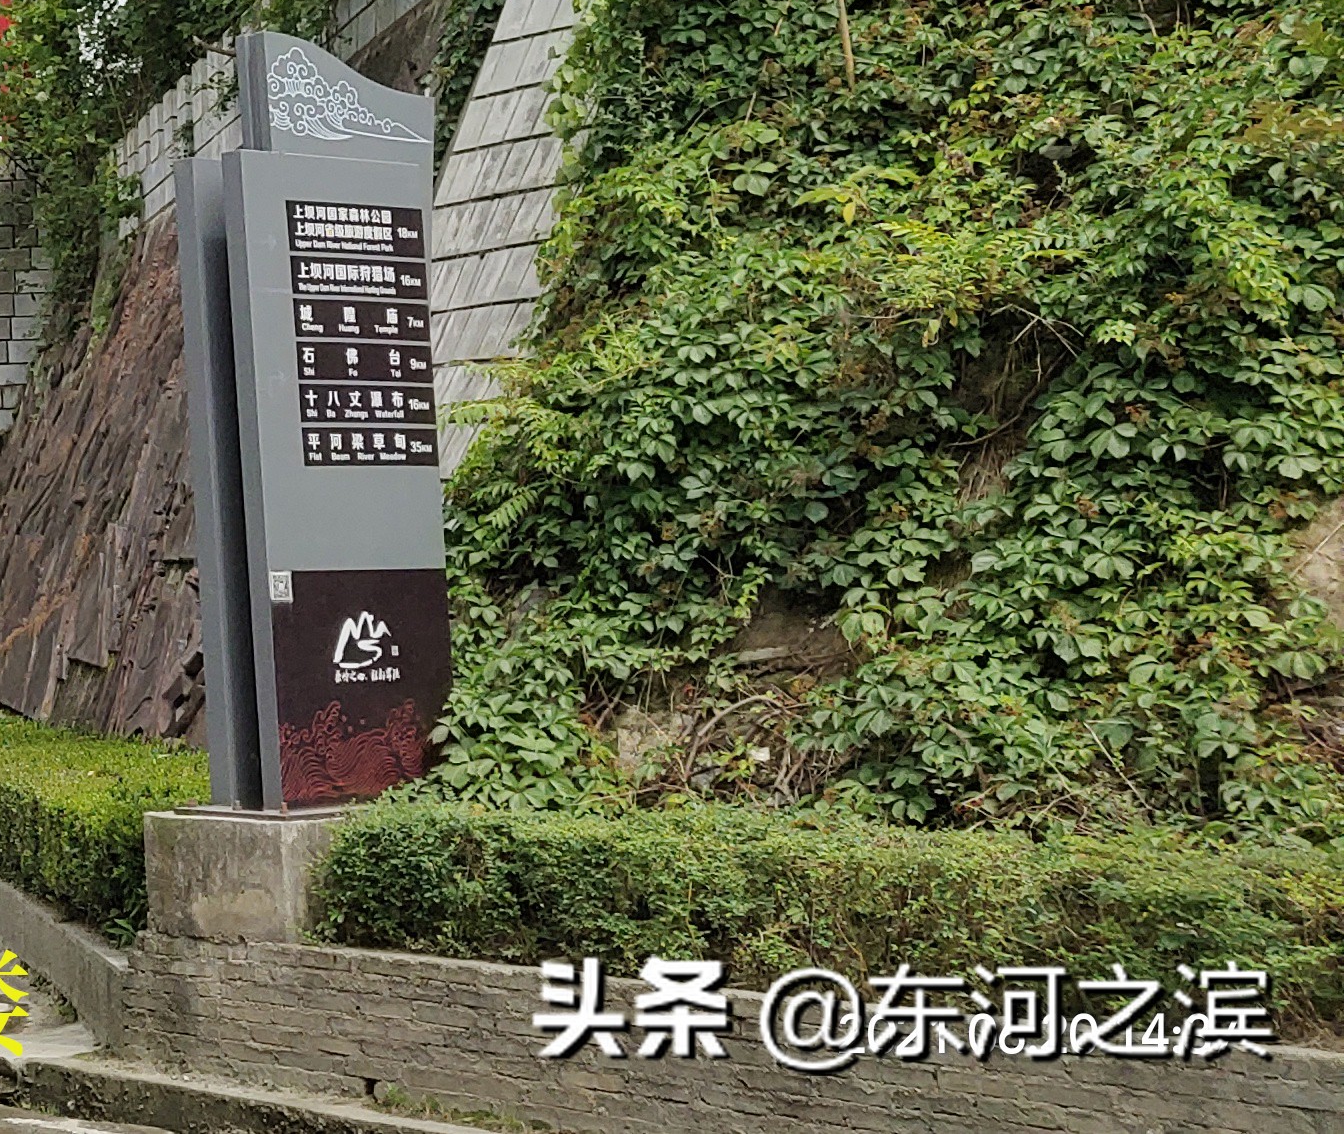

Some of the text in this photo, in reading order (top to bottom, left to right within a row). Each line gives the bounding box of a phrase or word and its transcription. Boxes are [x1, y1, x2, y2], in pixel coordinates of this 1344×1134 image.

[293, 204, 392, 224] 上坝河国家森林公园
[397, 227, 418, 239] 18KM
[297, 262, 396, 283] 上坝河国际狩猎场
[400, 275, 421, 287] 16KM
[407, 316, 424, 328] 7KM
[374, 325, 399, 336] Temple
[301, 347, 400, 366] 石佛台
[410, 358, 427, 370] 9KM
[305, 389, 404, 408] 十八丈瀑布
[408, 399, 430, 410] 16KM
[375, 410, 404, 418] Waterfall
[410, 441, 432, 453] 35KM
